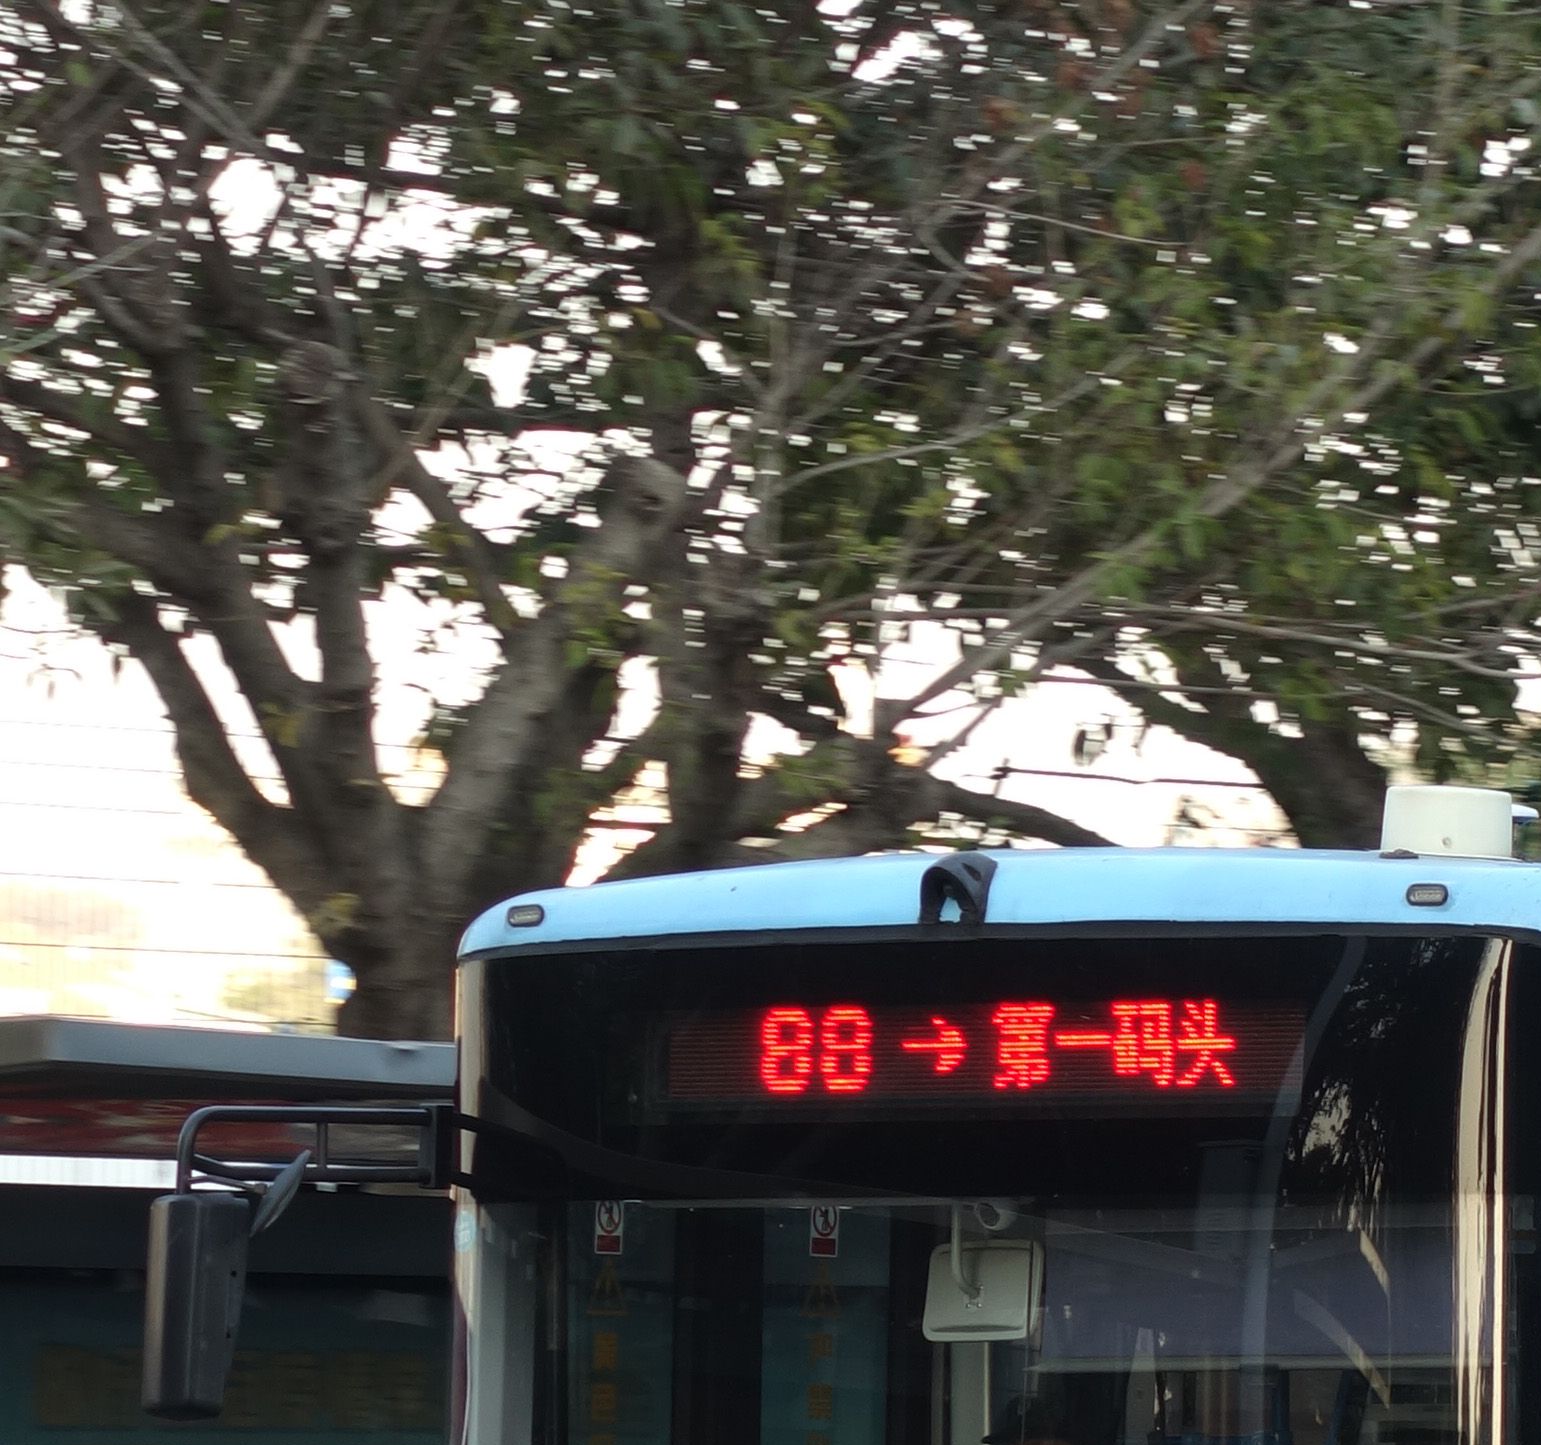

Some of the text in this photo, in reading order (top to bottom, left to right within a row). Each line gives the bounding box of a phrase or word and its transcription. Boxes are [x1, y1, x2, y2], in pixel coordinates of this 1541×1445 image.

[761, 999, 1236, 1092] 88 第一码头
